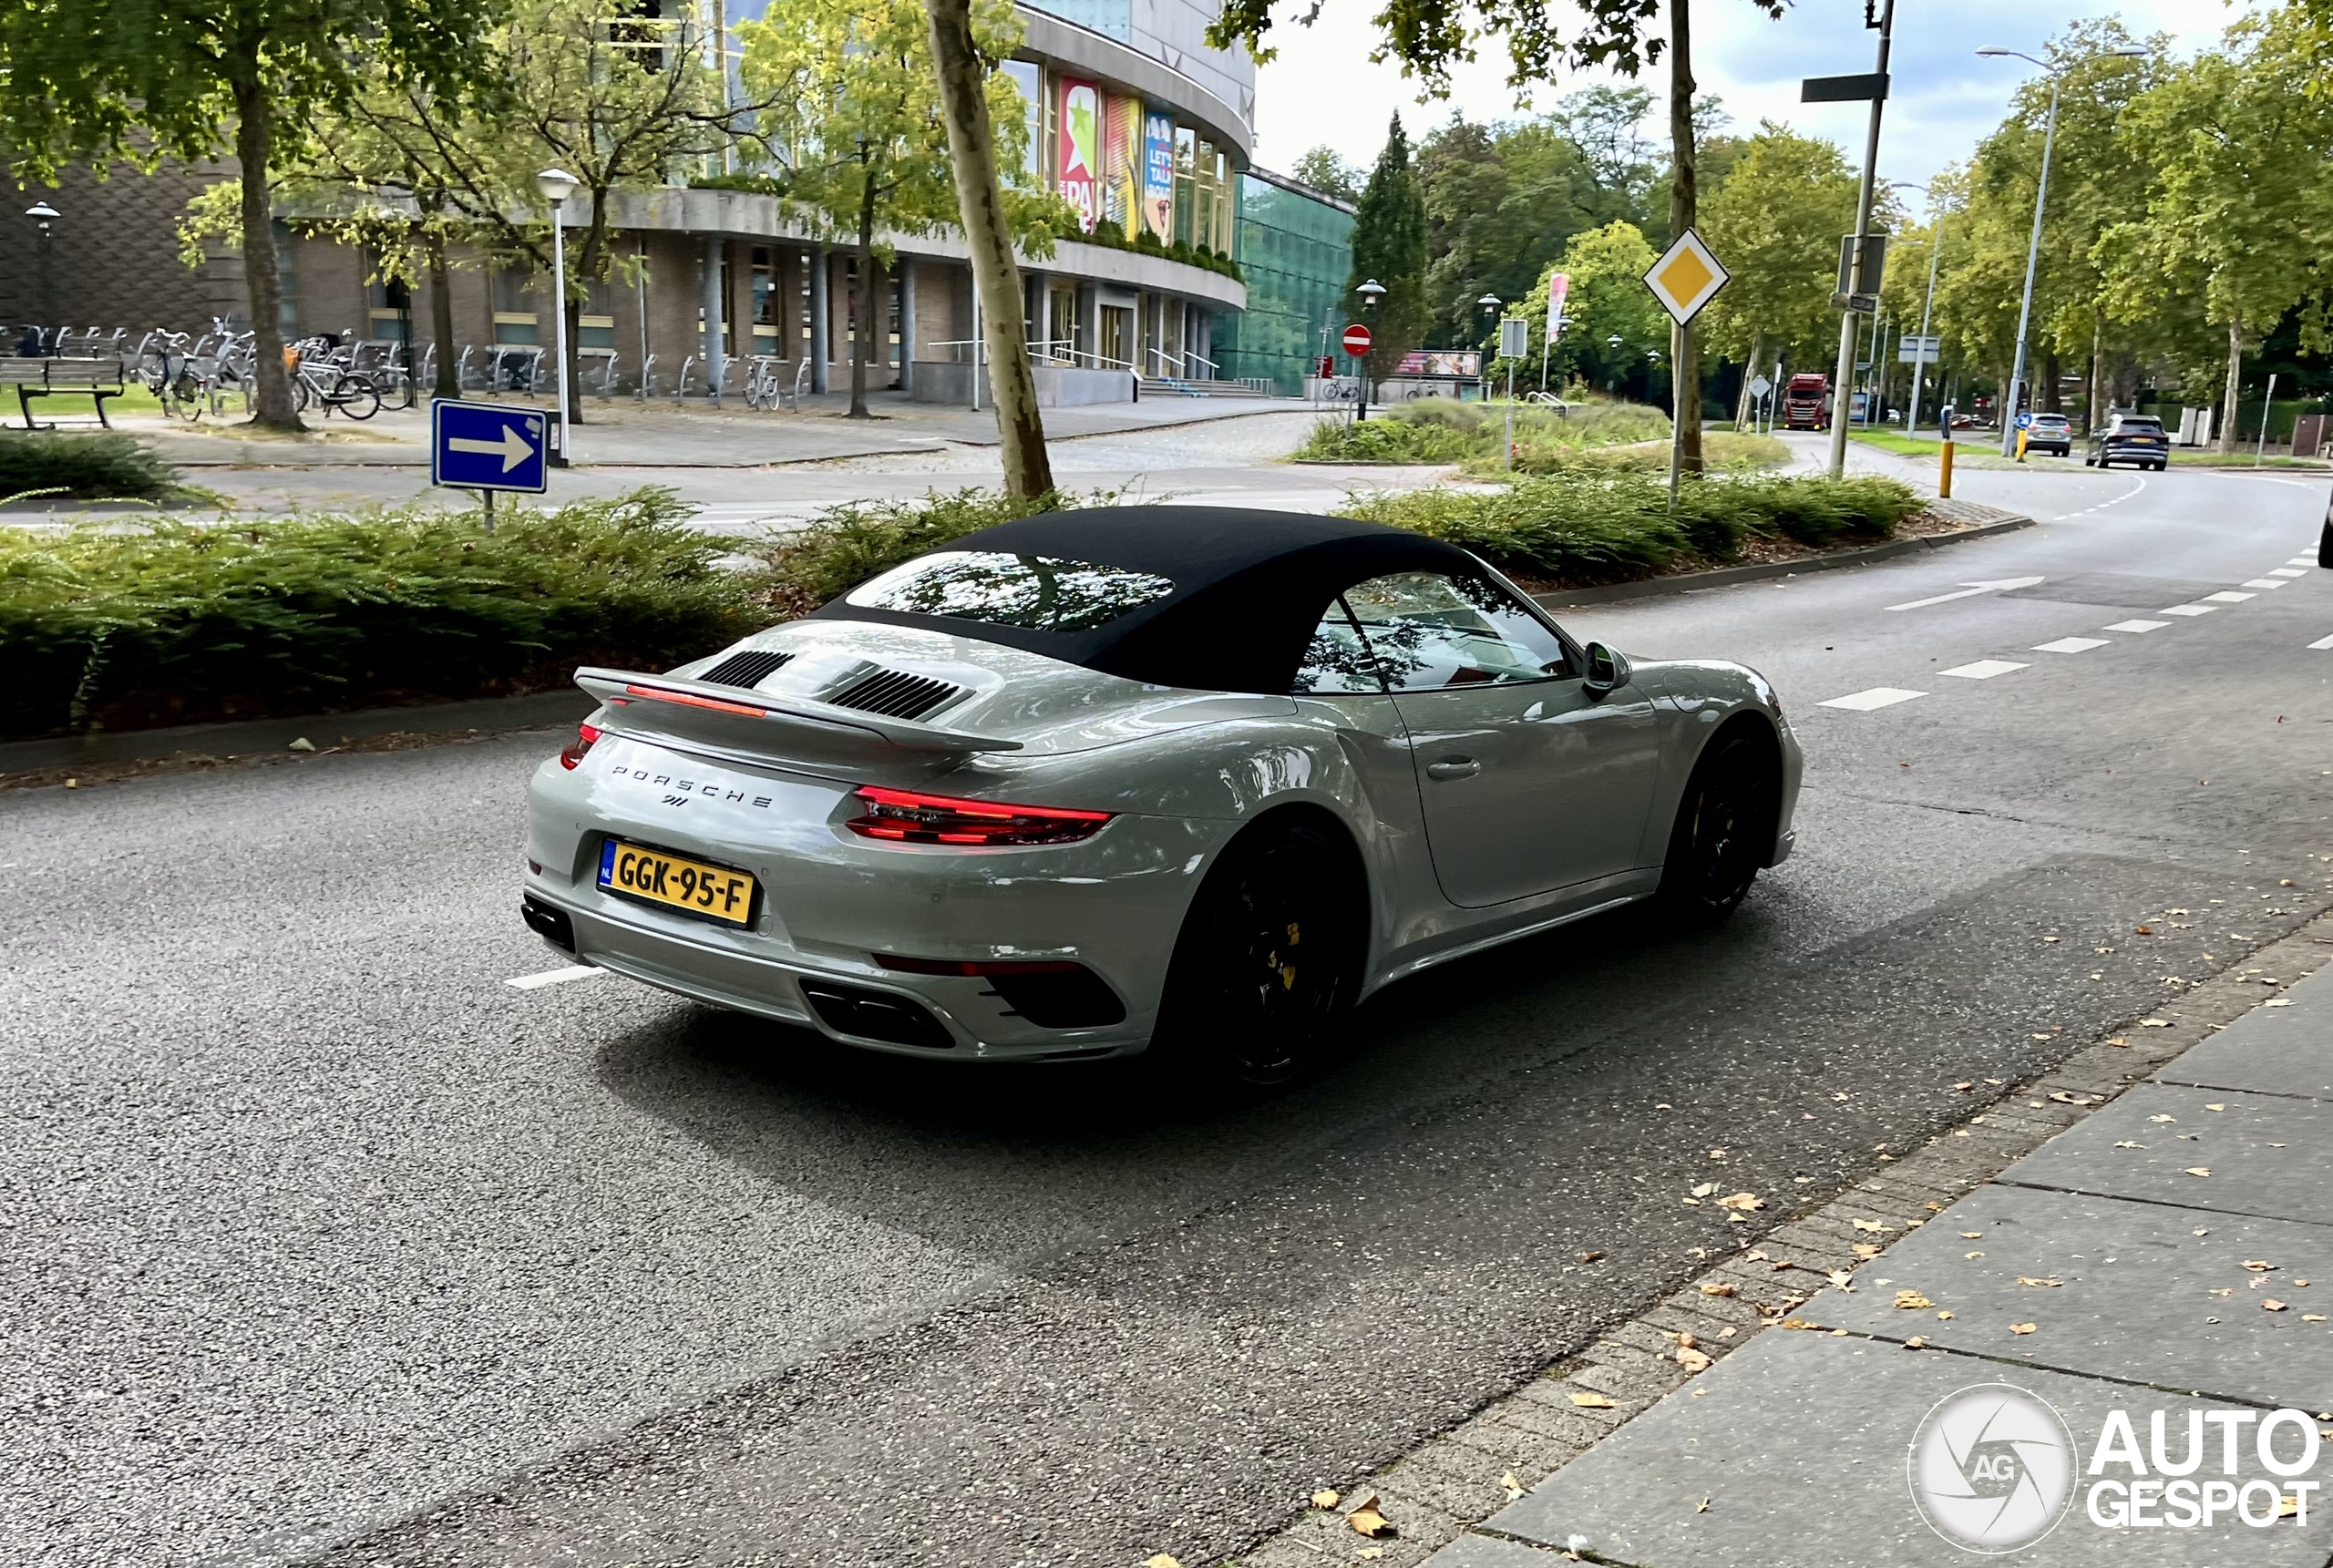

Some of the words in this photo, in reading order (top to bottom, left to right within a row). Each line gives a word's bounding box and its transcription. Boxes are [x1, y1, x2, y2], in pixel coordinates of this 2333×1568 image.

[612, 766, 772, 808] PORSCHE
[662, 794, 688, 807] 911
[601, 866, 611, 879] NL
[619, 852, 745, 912] GGK-95-F
